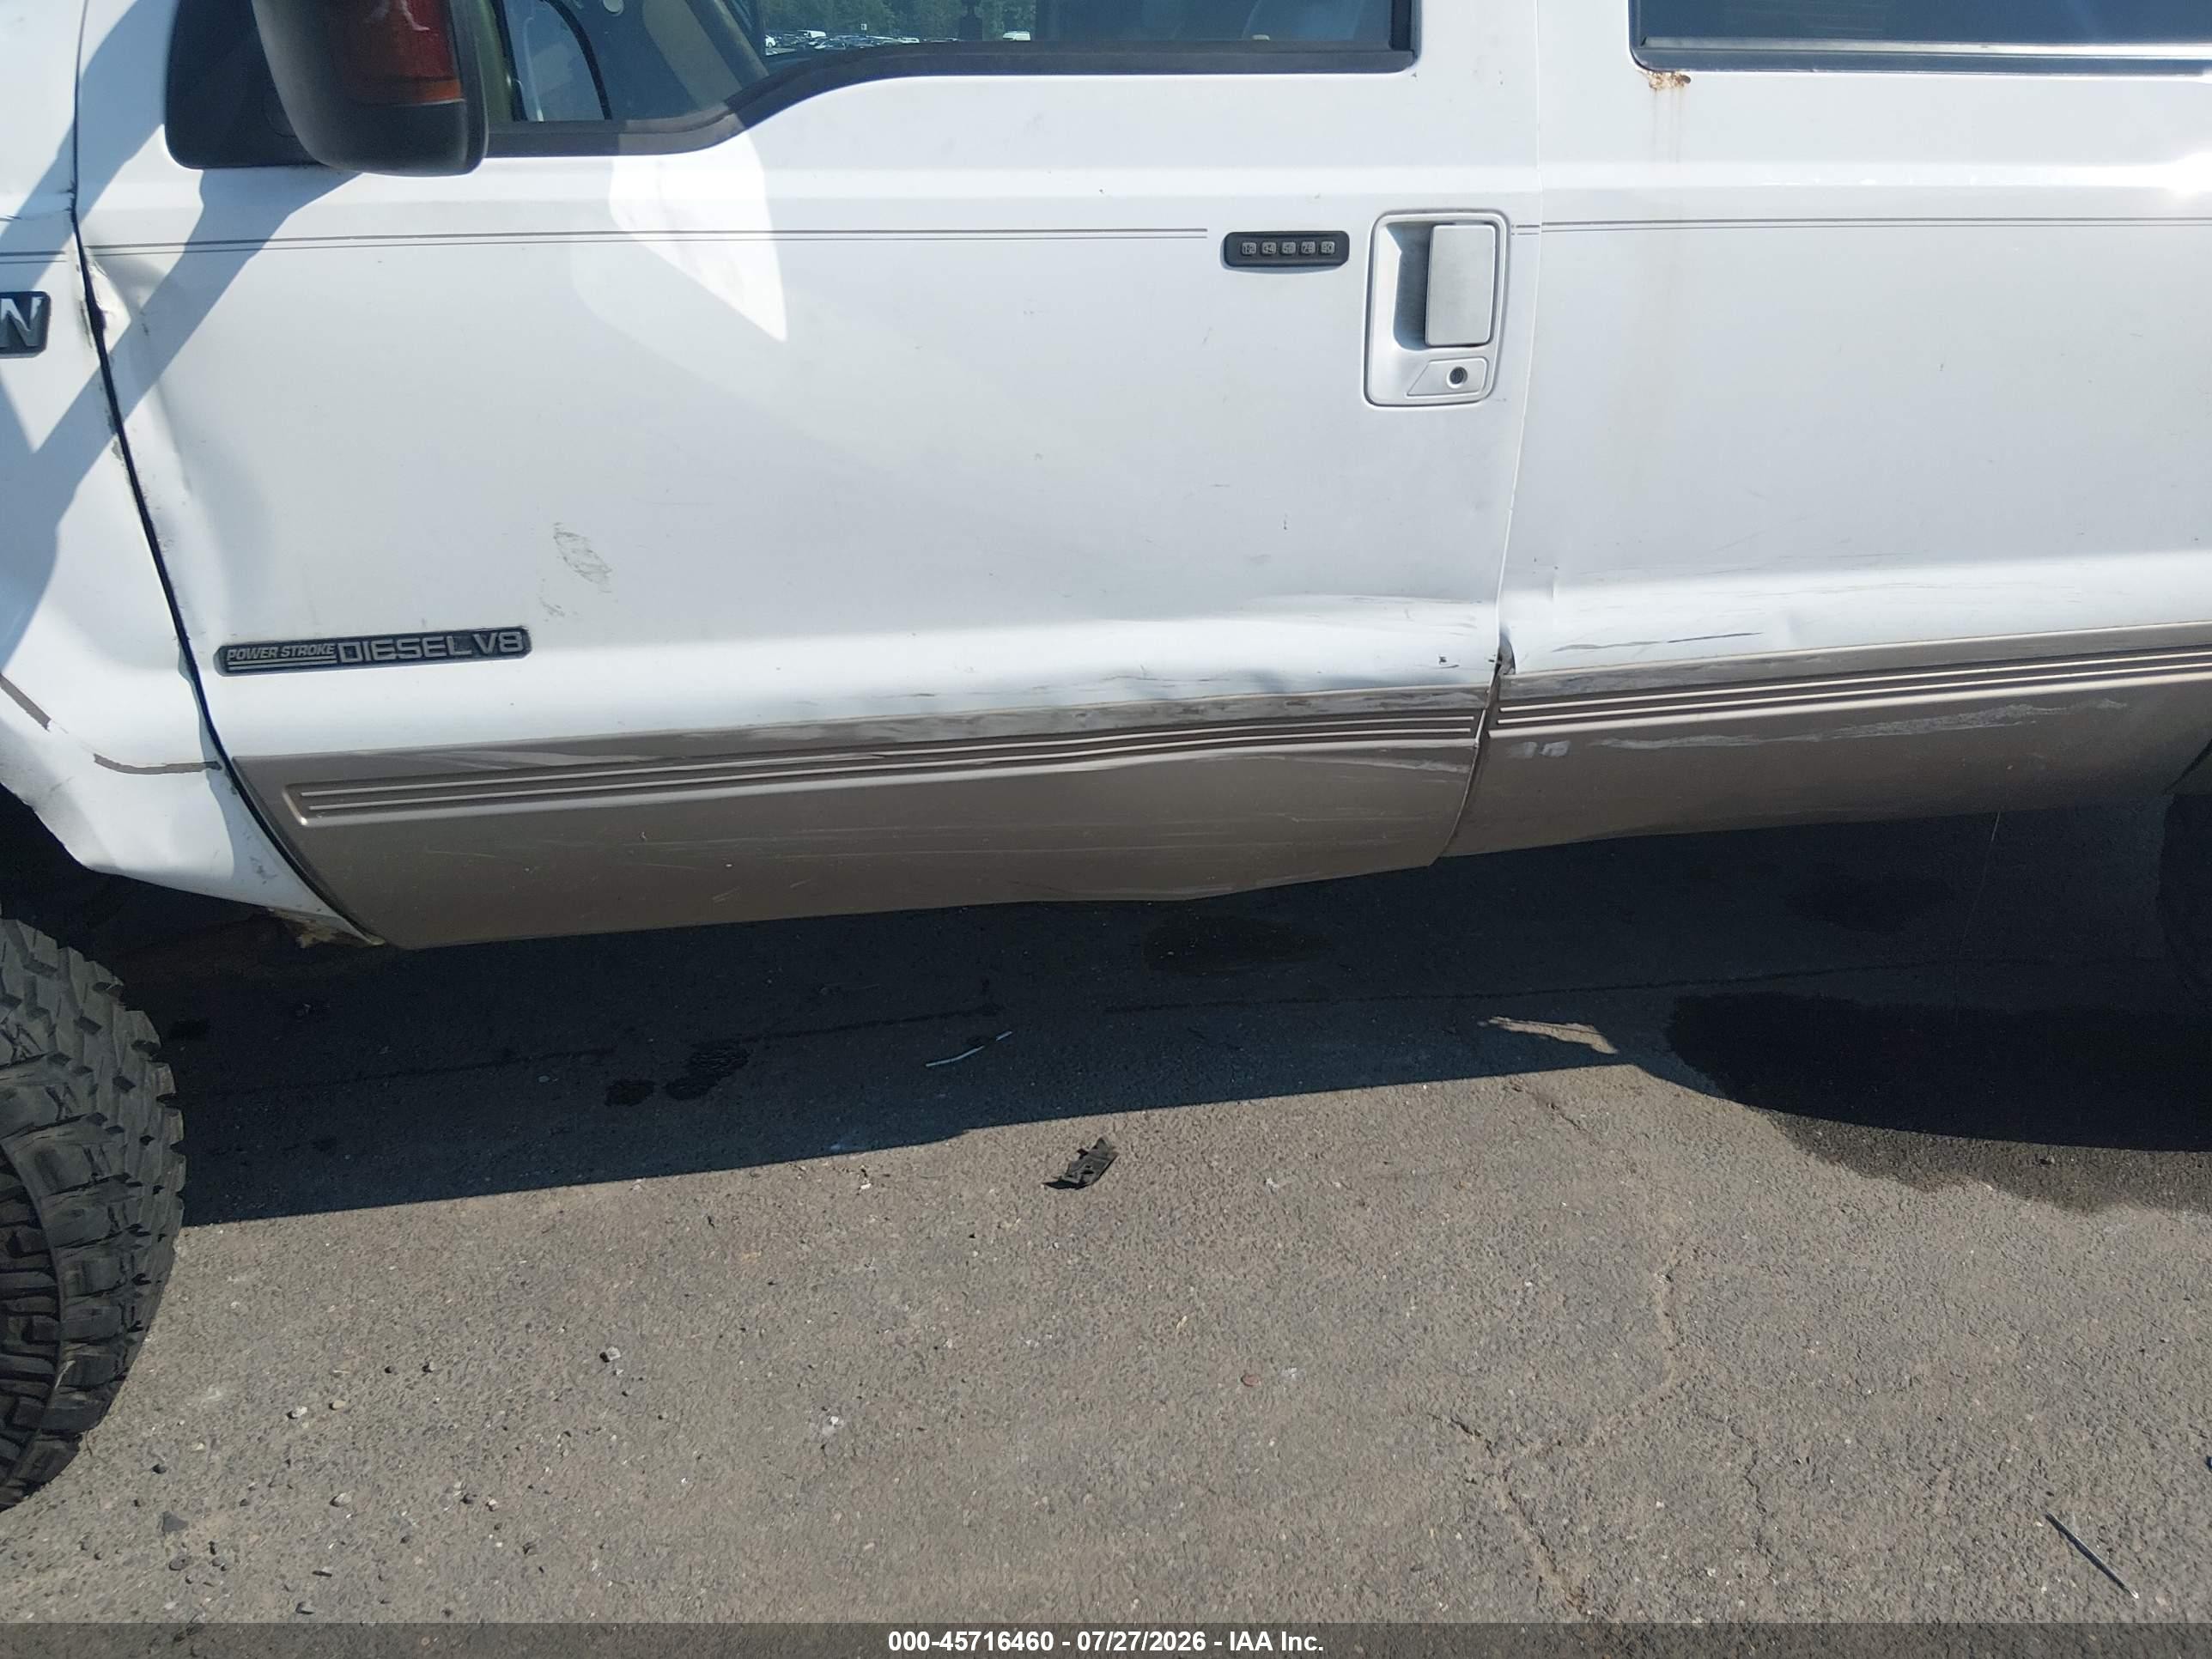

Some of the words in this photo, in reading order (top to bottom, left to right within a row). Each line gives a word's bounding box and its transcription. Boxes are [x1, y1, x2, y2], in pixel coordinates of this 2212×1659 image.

[0, 296, 43, 347] N
[227, 647, 278, 660] POWER
[281, 643, 336, 658] STROKE
[338, 635, 471, 663] DIESEL
[474, 631, 524, 653] V8
